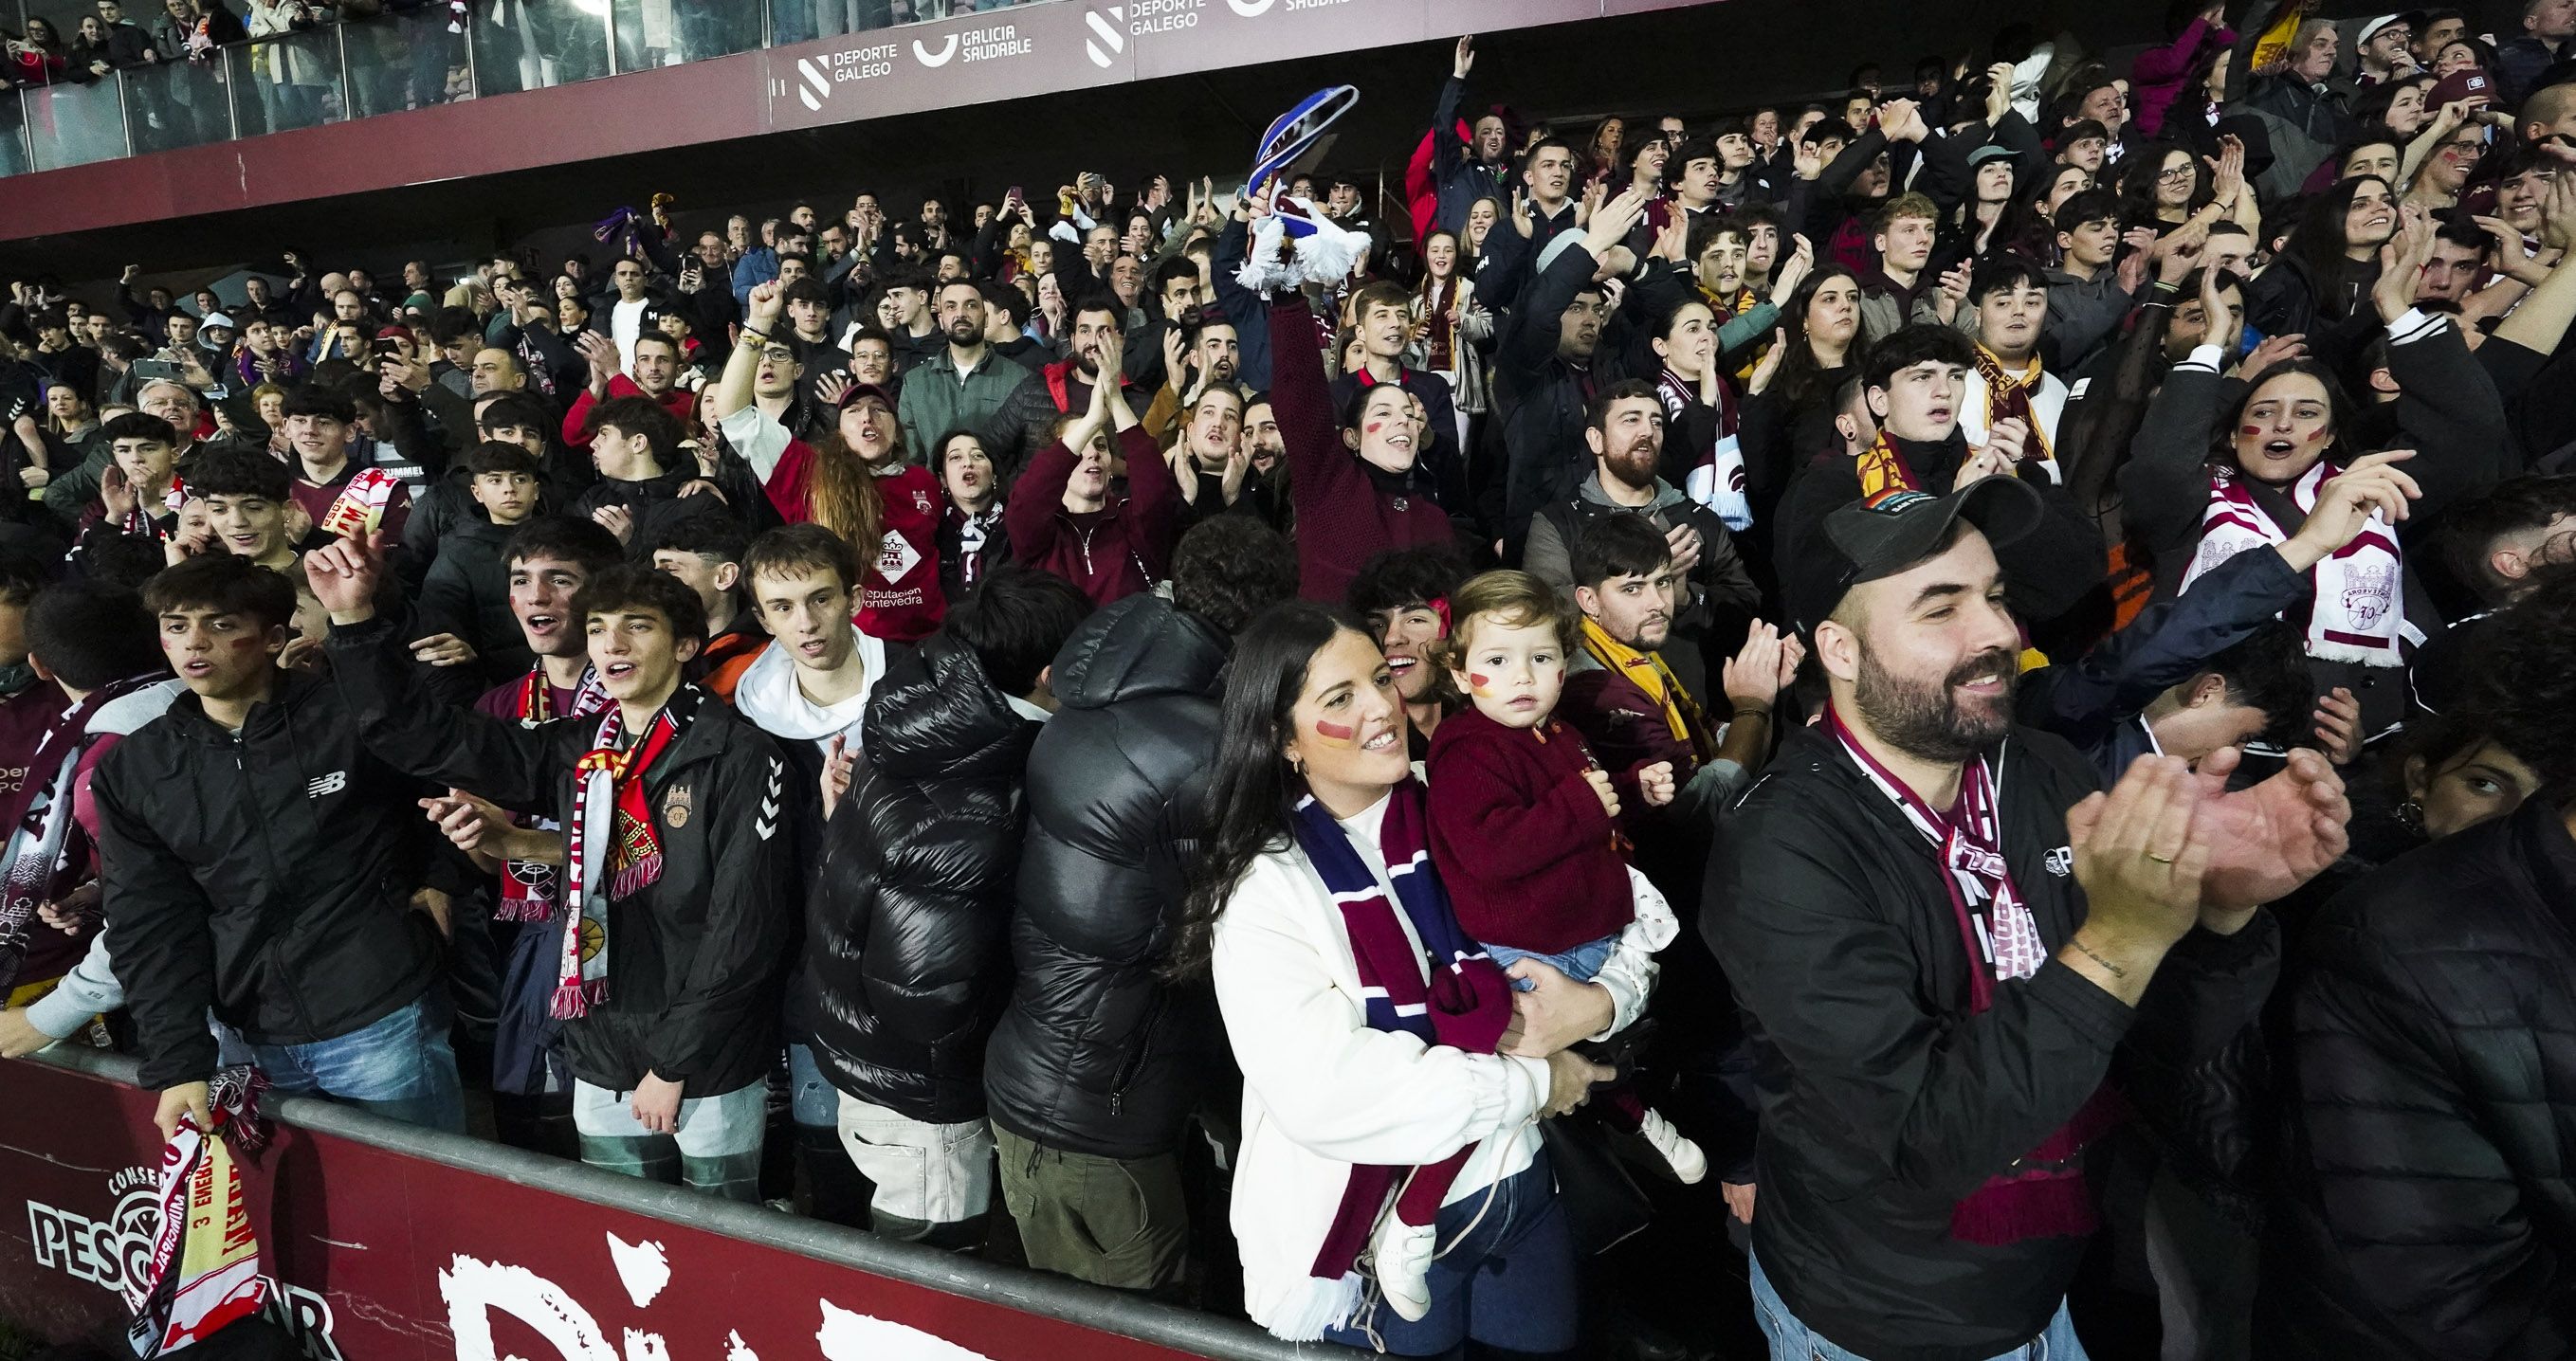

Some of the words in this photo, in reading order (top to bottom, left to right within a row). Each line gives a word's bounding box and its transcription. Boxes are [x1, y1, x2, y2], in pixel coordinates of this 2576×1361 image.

[1129, 12, 1198, 36] GALEGO
[962, 25, 1015, 46] GALICIA
[834, 44, 898, 66] DEPORTE
[962, 38, 1032, 63] SAUDABLE
[834, 62, 891, 82] GALEGO
[383, 465, 425, 478] UMMEL
